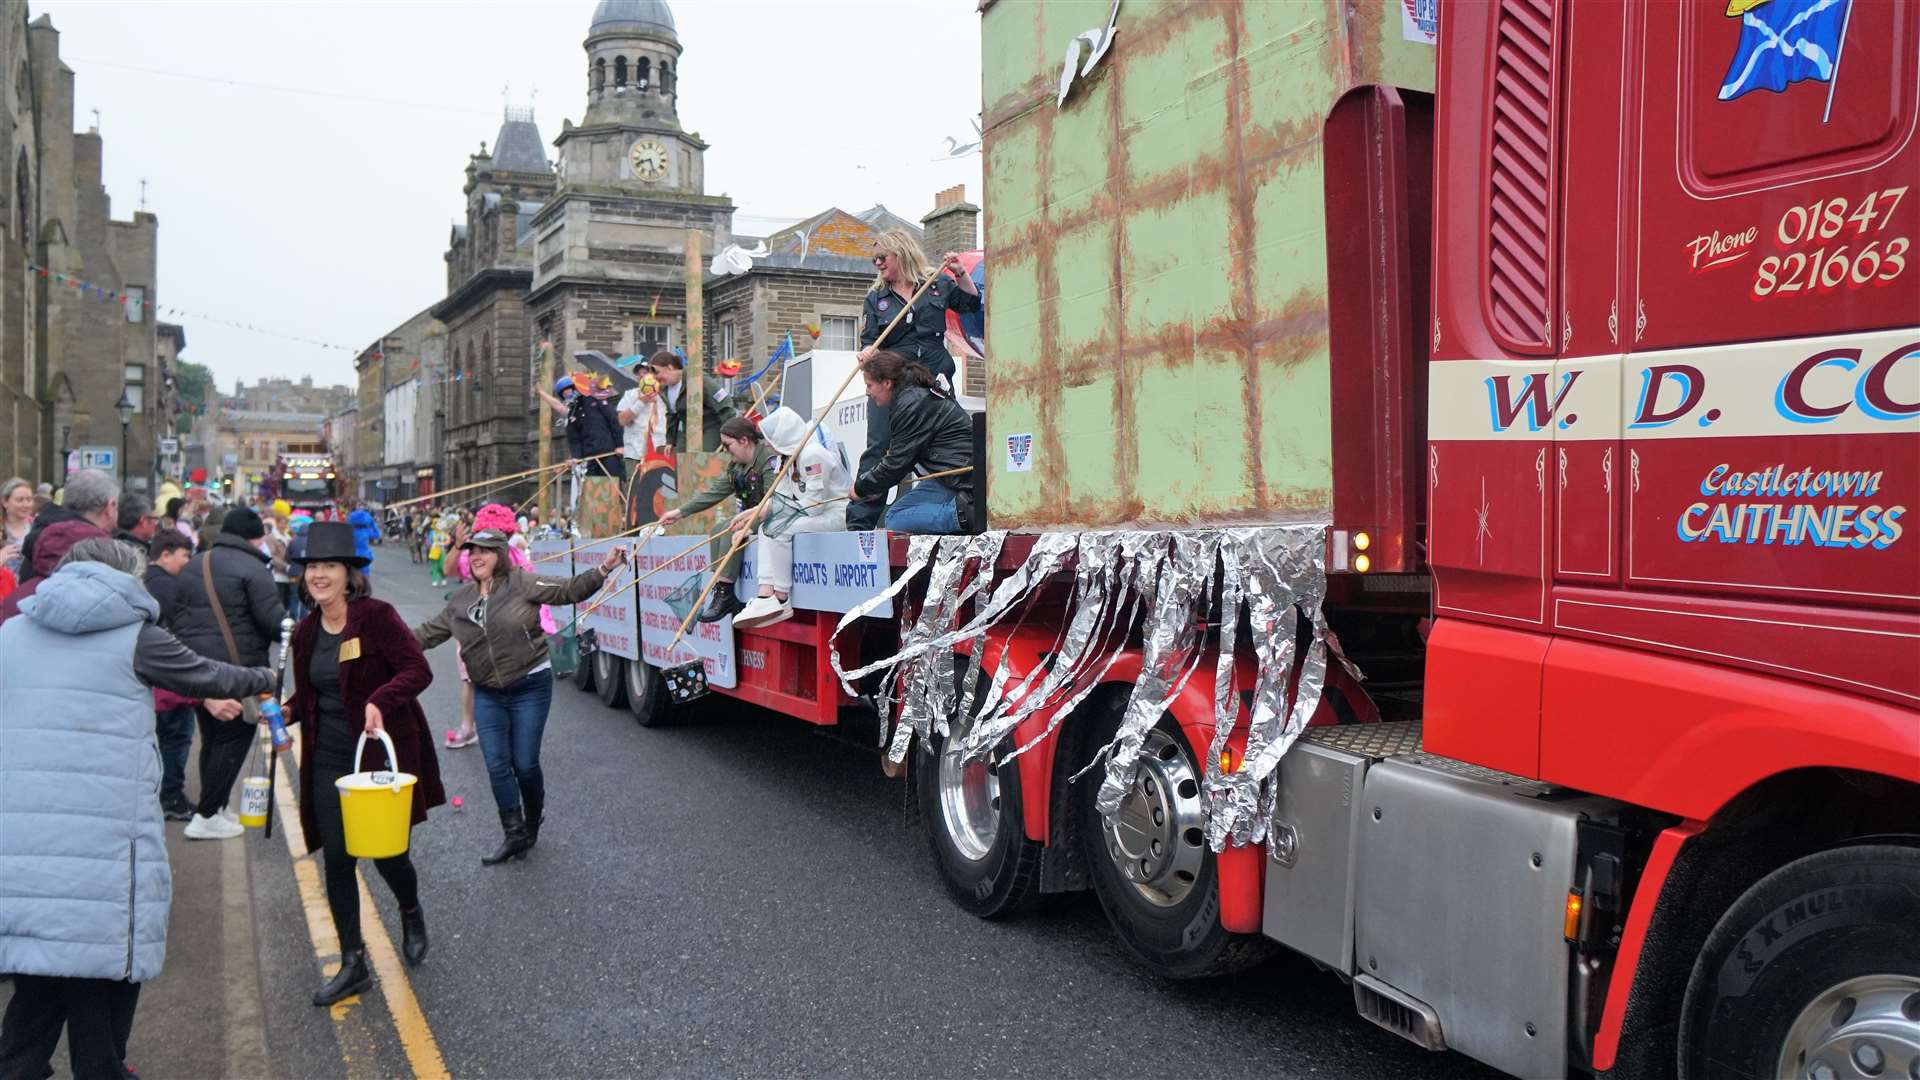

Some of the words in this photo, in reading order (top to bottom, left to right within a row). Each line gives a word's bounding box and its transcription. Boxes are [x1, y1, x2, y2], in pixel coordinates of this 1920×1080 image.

[1778, 186, 1909, 244] 01847
[1686, 226, 1758, 268] Phone
[1754, 237, 1909, 296] 821663
[1483, 370, 1584, 432] W.
[1628, 364, 1721, 429] D.
[1701, 463, 1883, 498] Castletown
[1677, 502, 1907, 550] CAITHNESS
[834, 564, 877, 587] AIRPORT
